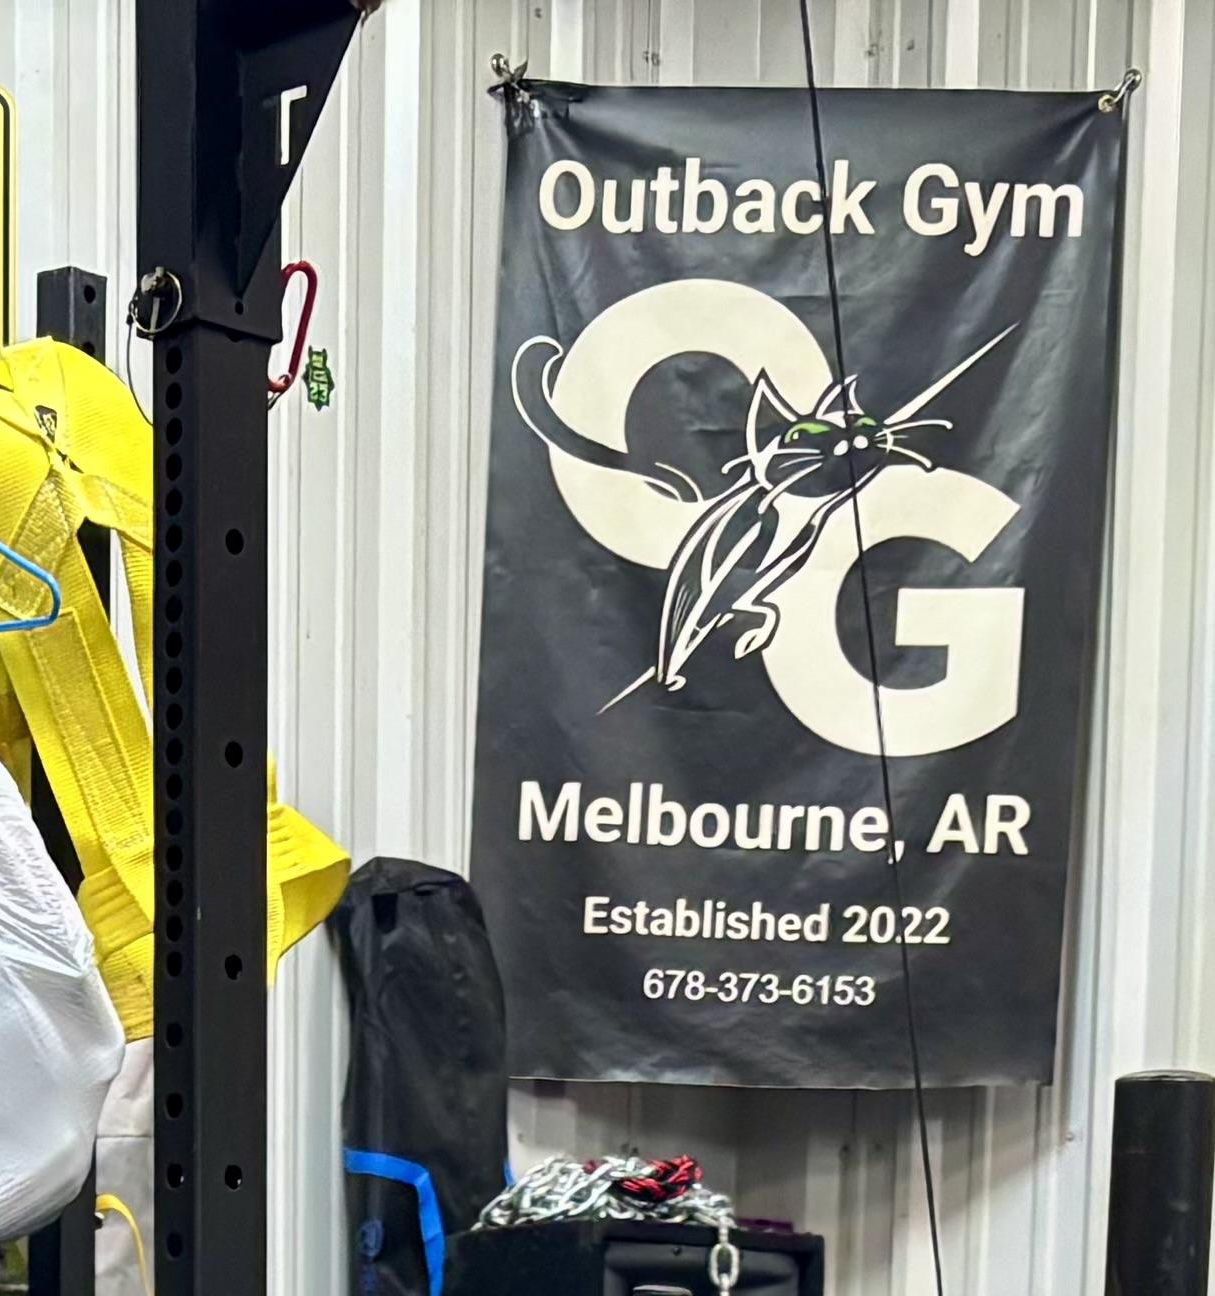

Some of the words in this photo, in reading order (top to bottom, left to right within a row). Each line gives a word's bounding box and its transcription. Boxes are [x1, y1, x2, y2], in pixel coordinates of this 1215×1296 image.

[539, 158, 877, 236] Outback
[903, 163, 1084, 256] Gym
[517, 781, 906, 865] Melbourne,
[926, 793, 1032, 856] AR
[583, 896, 830, 942] Established
[842, 905, 951, 945] 2022
[643, 968, 876, 1006] 678-373-6153
